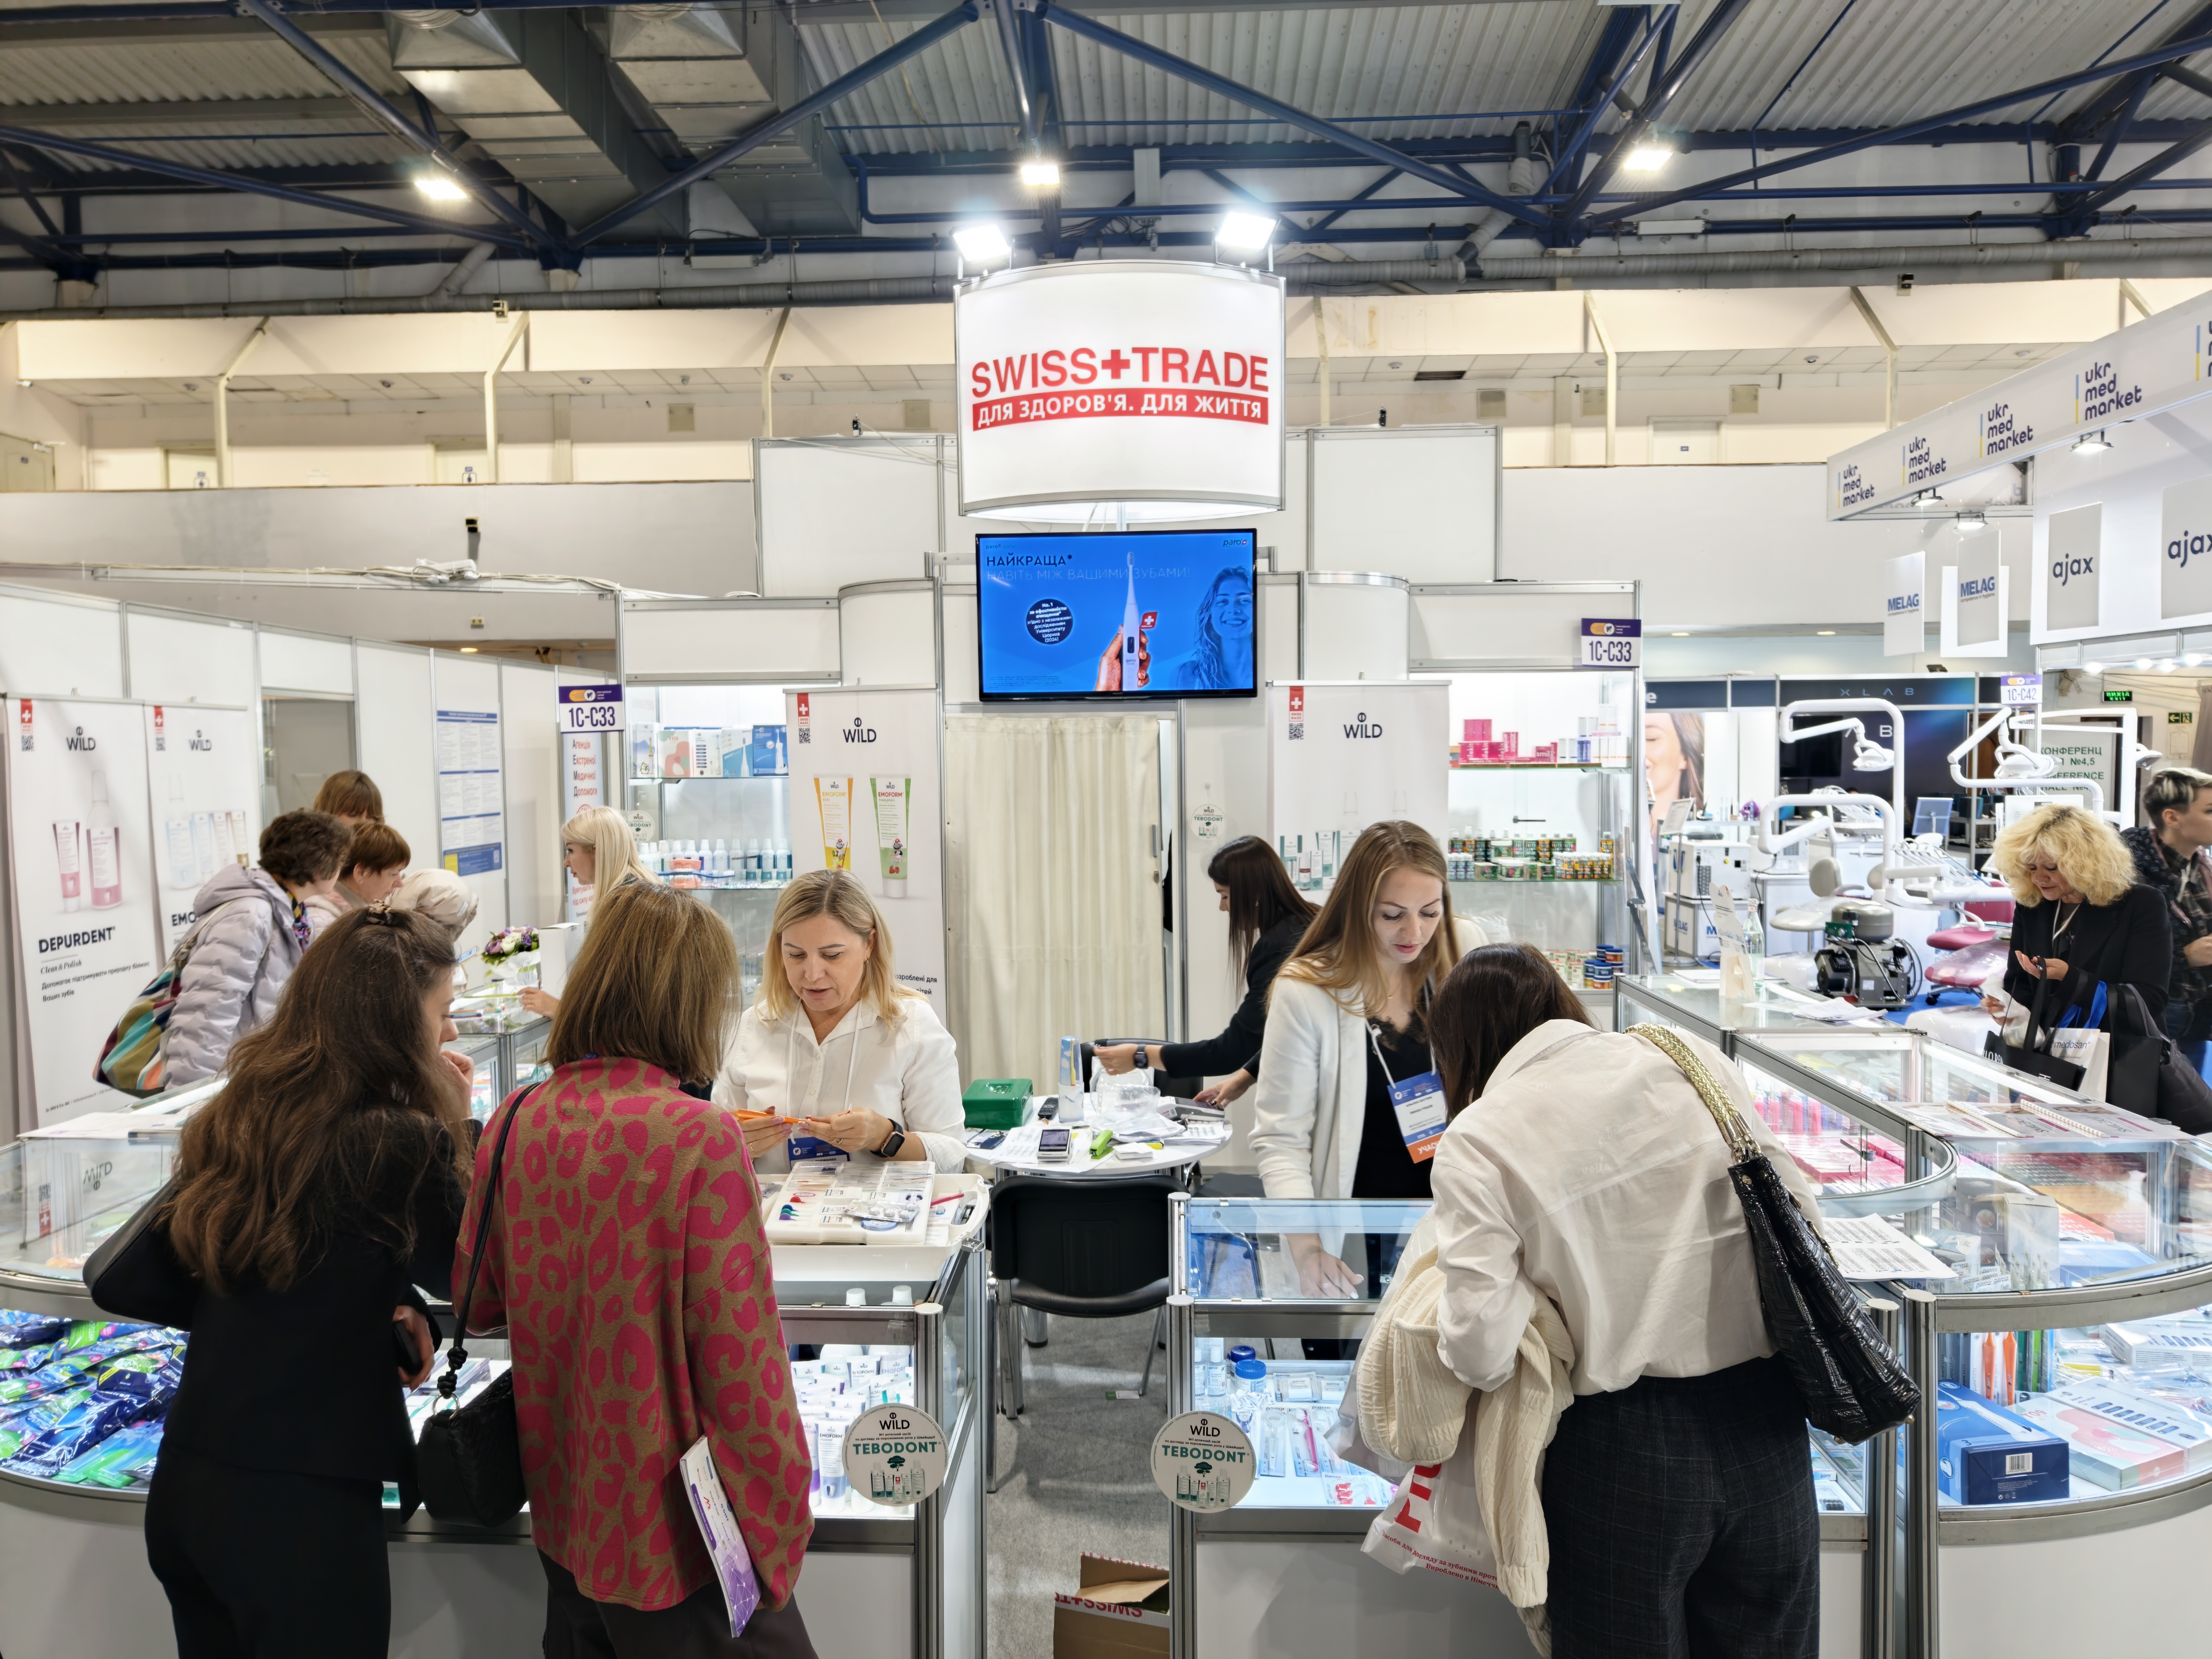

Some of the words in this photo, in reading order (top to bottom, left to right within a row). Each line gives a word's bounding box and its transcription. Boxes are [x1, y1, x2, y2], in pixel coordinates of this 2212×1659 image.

[2085, 363, 2111, 384] ukr
[2085, 374, 2117, 402] med
[978, 403, 1013, 427] ДЛЯ
[1020, 394, 1134, 419] ЗДОРОВ'Я.
[1141, 394, 1187, 413] ДЛЯ
[1194, 396, 1262, 418] ЖИТТЯ
[2085, 385, 2142, 421] market
[1988, 403, 2008, 422] ukr
[1988, 414, 2013, 438] med
[1909, 437, 1926, 453] ukr
[1987, 426, 2033, 455] market
[1909, 447, 1930, 468] med
[1843, 464, 1858, 479] ukr
[1909, 458, 1946, 484] market
[1843, 474, 1861, 493] med
[1843, 484, 1875, 508] market
[2168, 530, 2212, 568] ajax
[987, 569, 1033, 581] НАВІТЬ
[1037, 570, 1063, 580] МІЖ
[2053, 553, 2093, 586] ajax
[1961, 576, 1995, 597] MELAG
[1888, 594, 1919, 612] MELAG
[1589, 641, 1632, 662] 1C-C33
[2007, 688, 2036, 701] 1C-C42
[569, 706, 616, 727] 1C-C33
[843, 728, 877, 743] WILD
[1343, 724, 1382, 739] WILD
[67, 737, 96, 751] WILD
[189, 739, 212, 751] WILD
[573, 739, 591, 750] Агенція
[573, 754, 596, 766] Екстреної
[574, 770, 596, 781] Медичної
[574, 786, 598, 798] Допомоги
[41, 965, 57, 975] Clean
[58, 962, 63, 972] &
[63, 959, 82, 970] Polish
[42, 978, 71, 990] Допомагає
[72, 969, 107, 984] підтримувати
[43, 993, 61, 1002] Ваших
[61, 989, 75, 999] зубів
[2054, 1041, 2087, 1049] medosan
[879, 1420, 910, 1430] WILD
[1190, 1425, 1220, 1437] WILD
[853, 1441, 937, 1455] TEBODONT
[1162, 1445, 1246, 1463] TEBODONT
[1382, 1530, 1401, 1546] Засоби
[1402, 1543, 1413, 1553] для
[1413, 1550, 1438, 1564] догляду
[1447, 1562, 1478, 1575] зубними
[1479, 1571, 1498, 1581] проте
[1426, 1563, 1464, 1580] Вироблено
